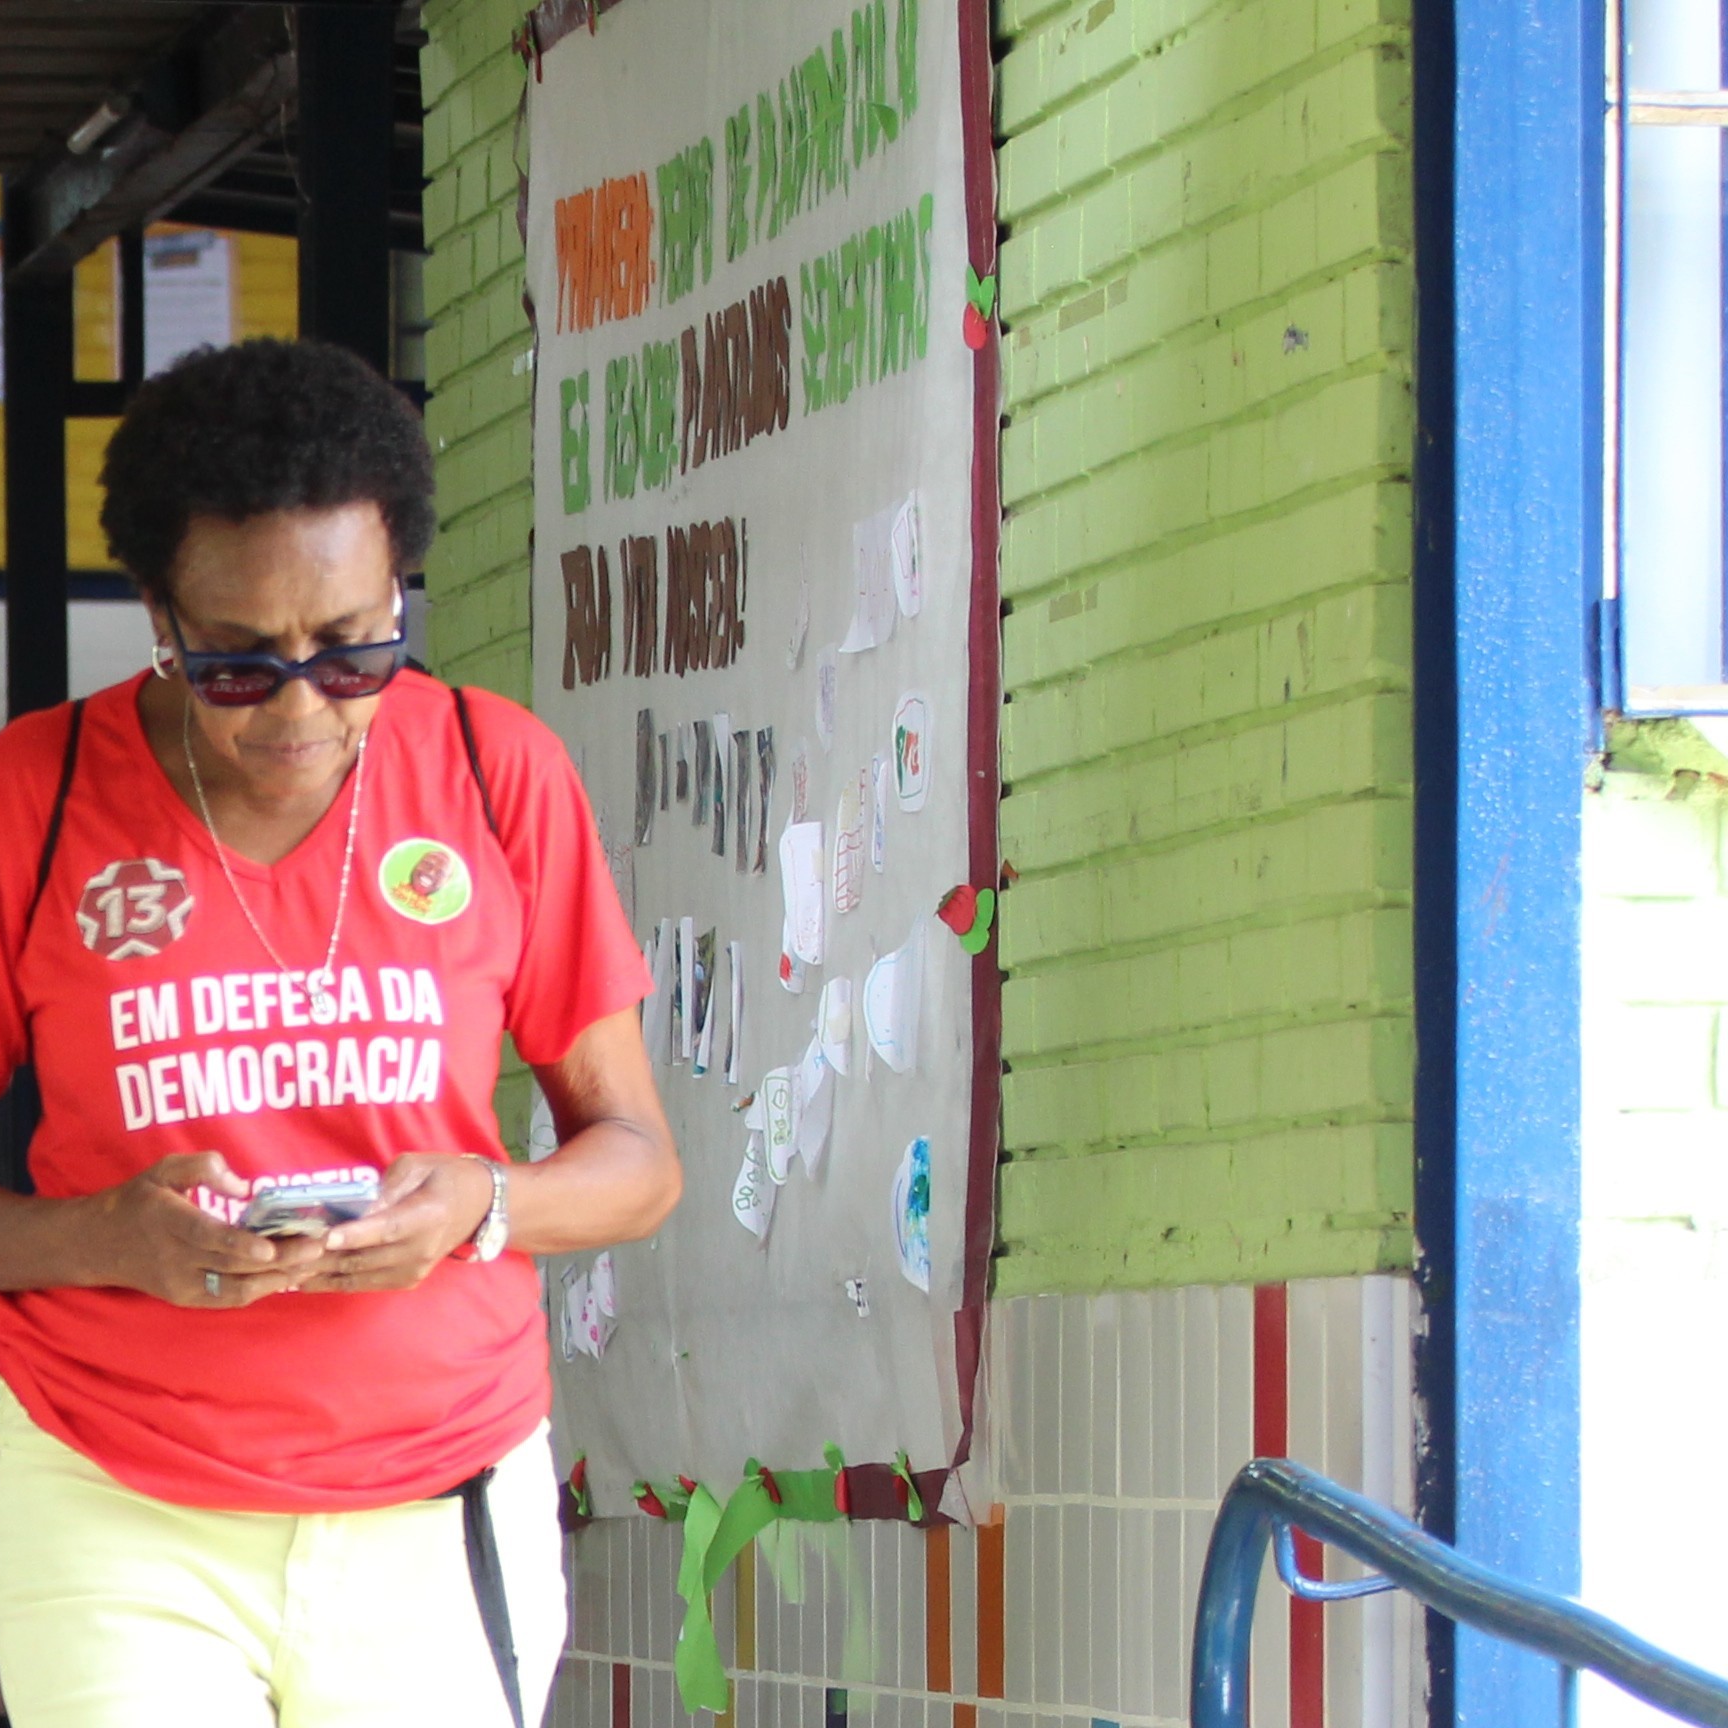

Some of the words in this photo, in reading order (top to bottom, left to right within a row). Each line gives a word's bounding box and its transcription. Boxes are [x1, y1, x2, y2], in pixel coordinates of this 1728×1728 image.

[95, 883, 168, 939] 13
[110, 982, 181, 1050] EM
[190, 966, 373, 1035] DEFESA
[378, 966, 444, 1026] DA
[115, 1036, 442, 1132] DEMOCRACIA
